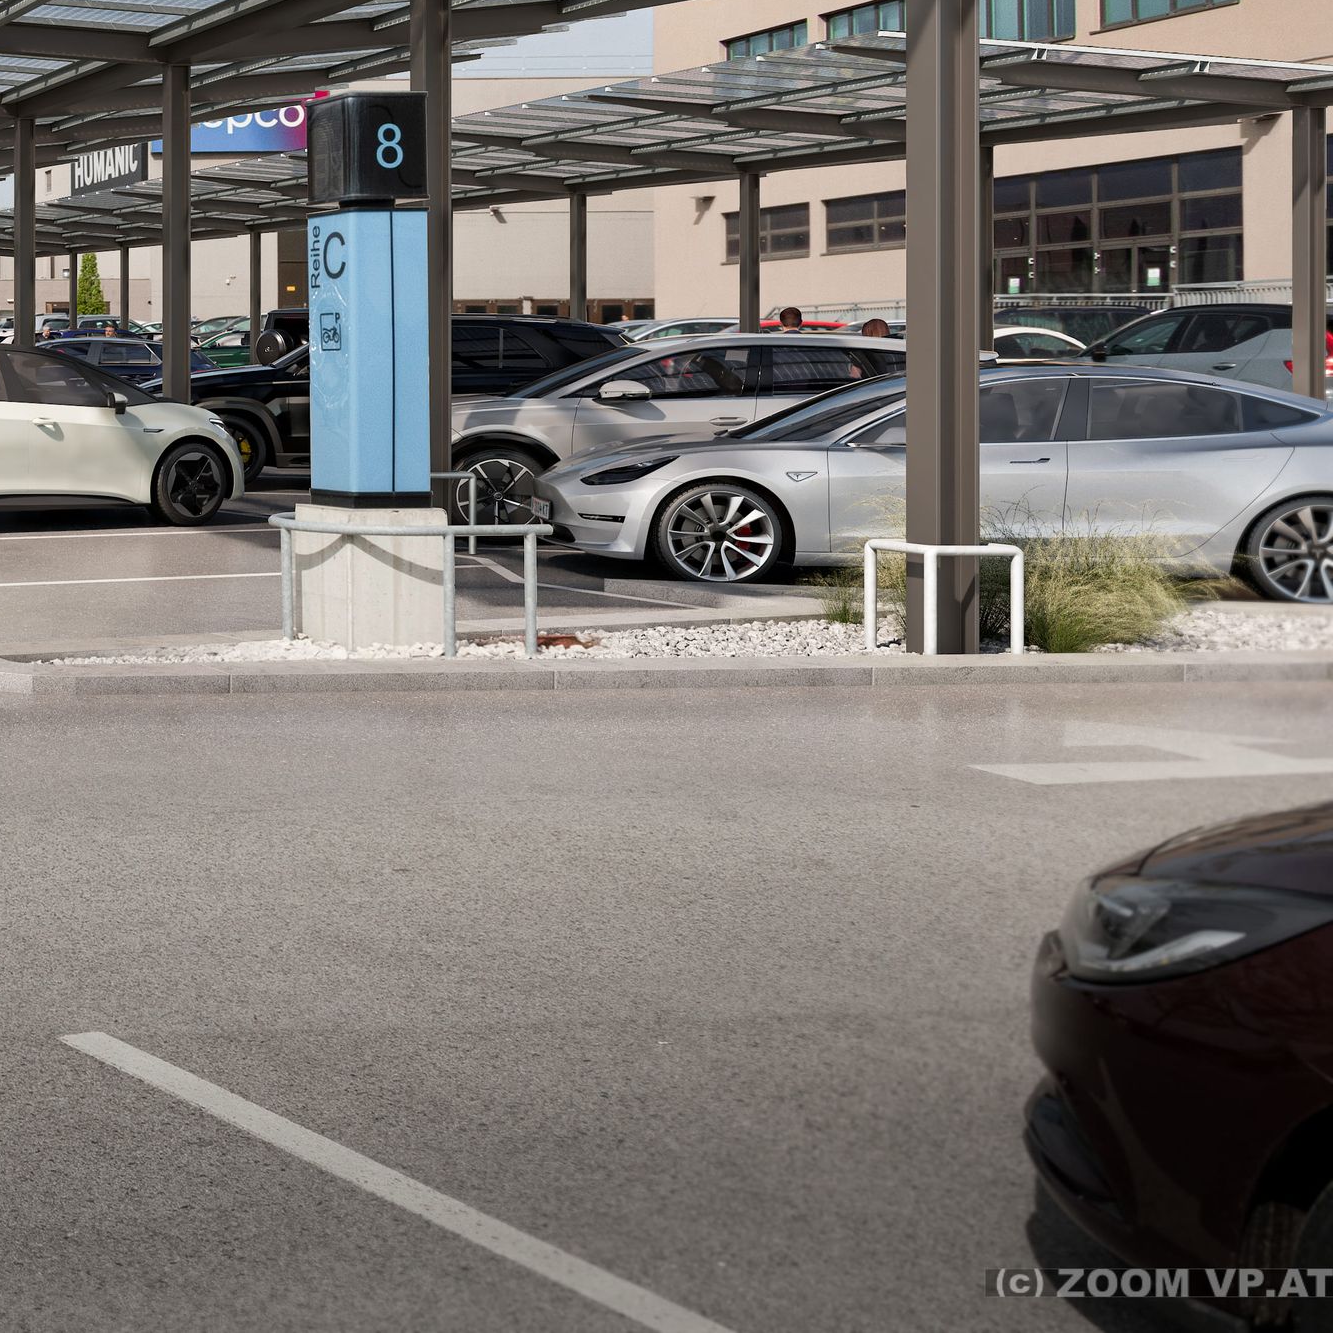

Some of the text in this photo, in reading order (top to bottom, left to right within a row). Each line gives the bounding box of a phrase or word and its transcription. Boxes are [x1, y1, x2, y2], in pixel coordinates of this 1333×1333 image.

[202, 105, 305, 134] pco
[75, 144, 138, 189] HUMANIC
[376, 122, 404, 169] 8
[310, 225, 321, 289] Reihe
[323, 231, 346, 279] C
